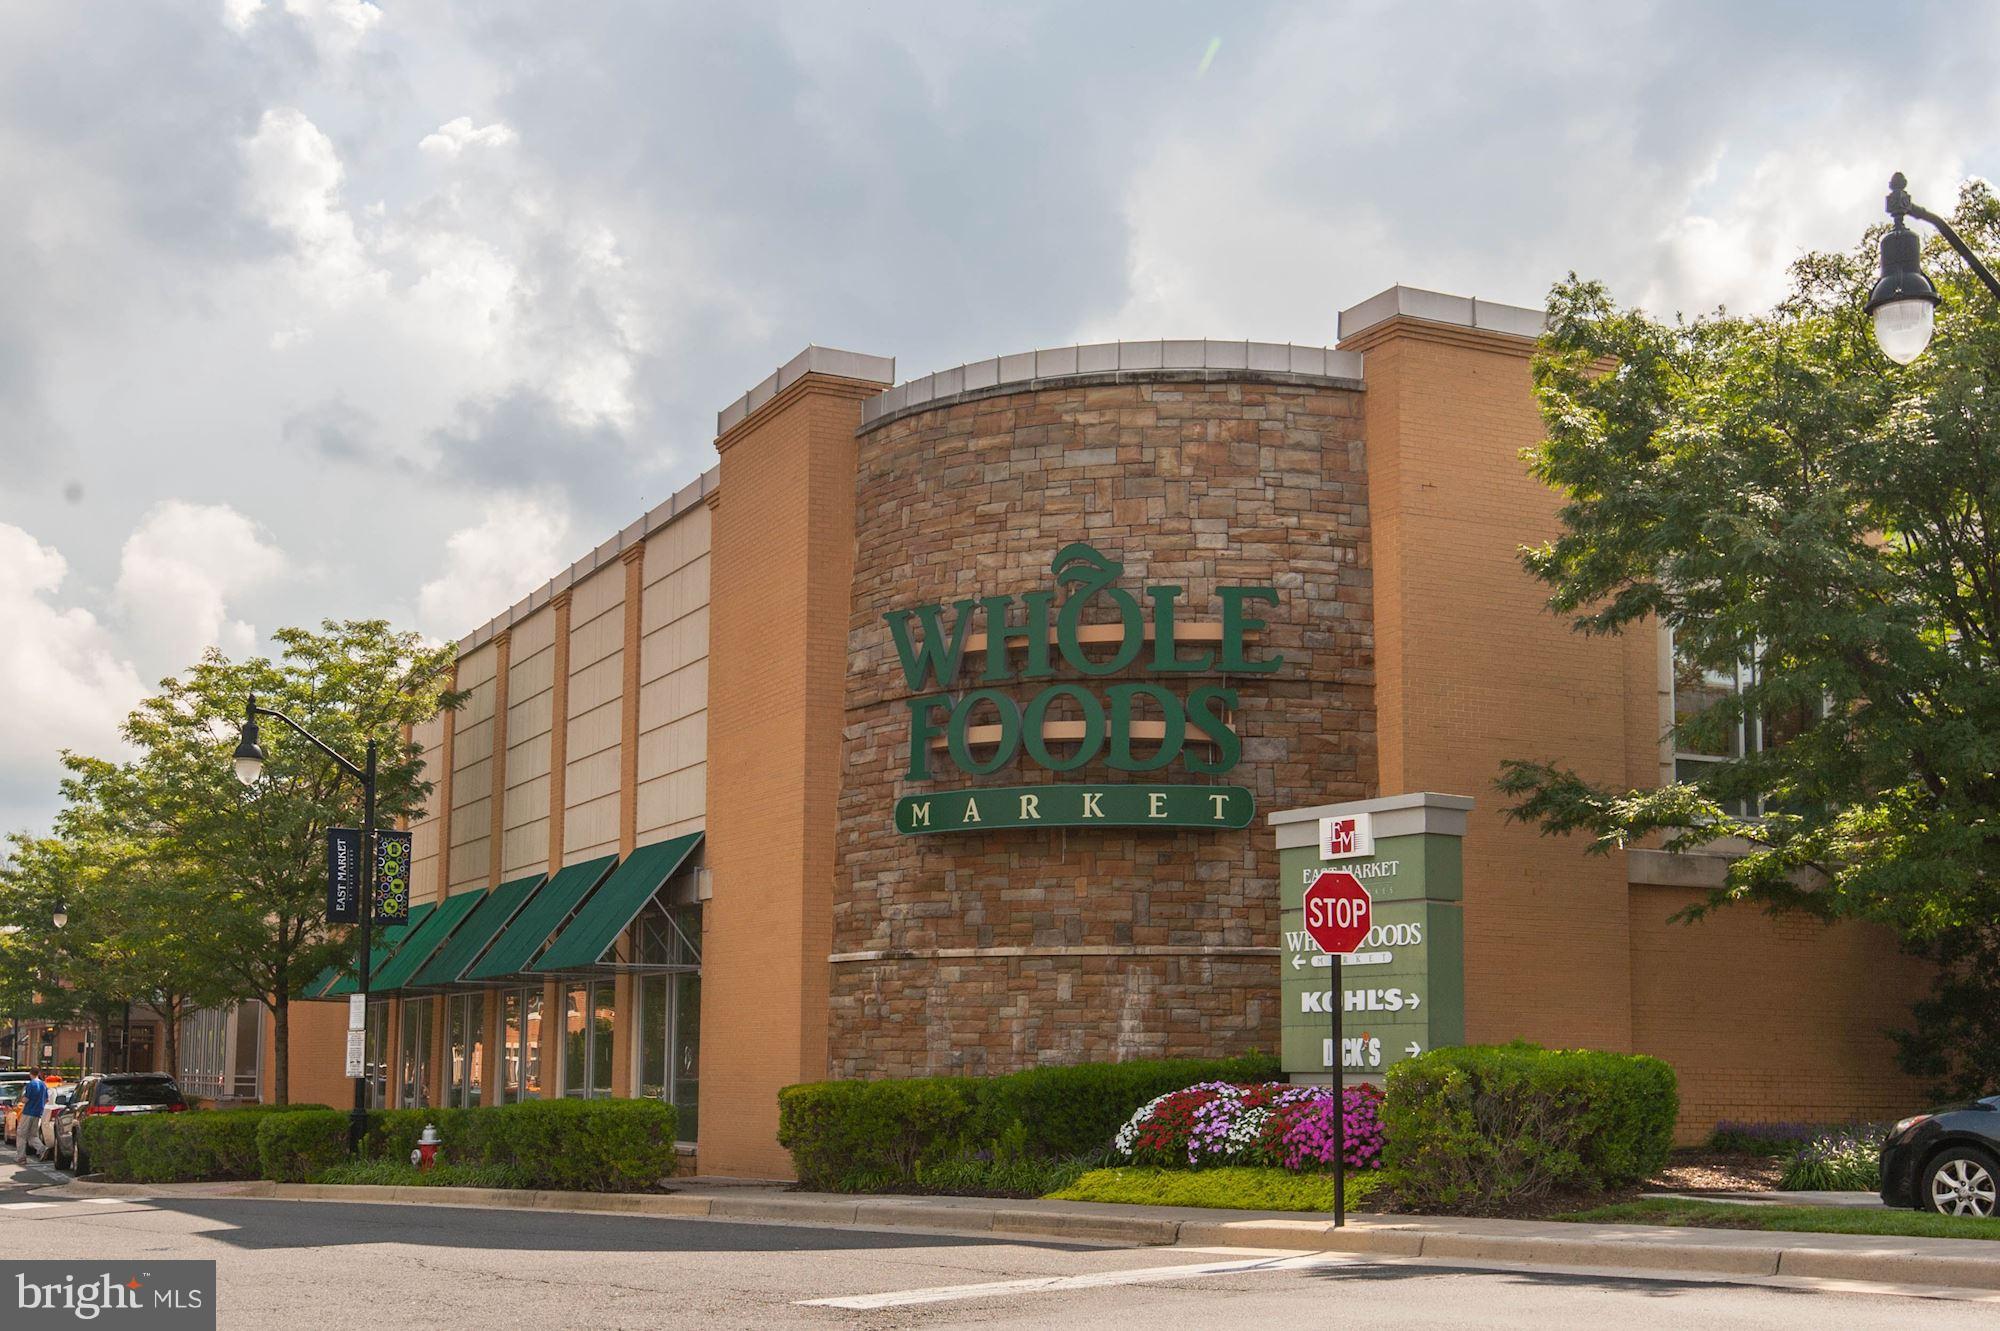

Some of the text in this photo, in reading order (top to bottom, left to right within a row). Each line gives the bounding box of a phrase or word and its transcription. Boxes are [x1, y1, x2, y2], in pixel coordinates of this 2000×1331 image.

[882, 552, 1283, 692] WHOLE
[904, 683, 1241, 782] FOODS
[911, 793, 1230, 828] MARKET
[336, 839, 347, 911] EAST MARKET
[1309, 897, 1367, 928] STOP
[1360, 923, 1421, 948] OODS
[1317, 953, 1388, 965] MRKET
[1323, 1036, 1380, 1067] DCK'S
